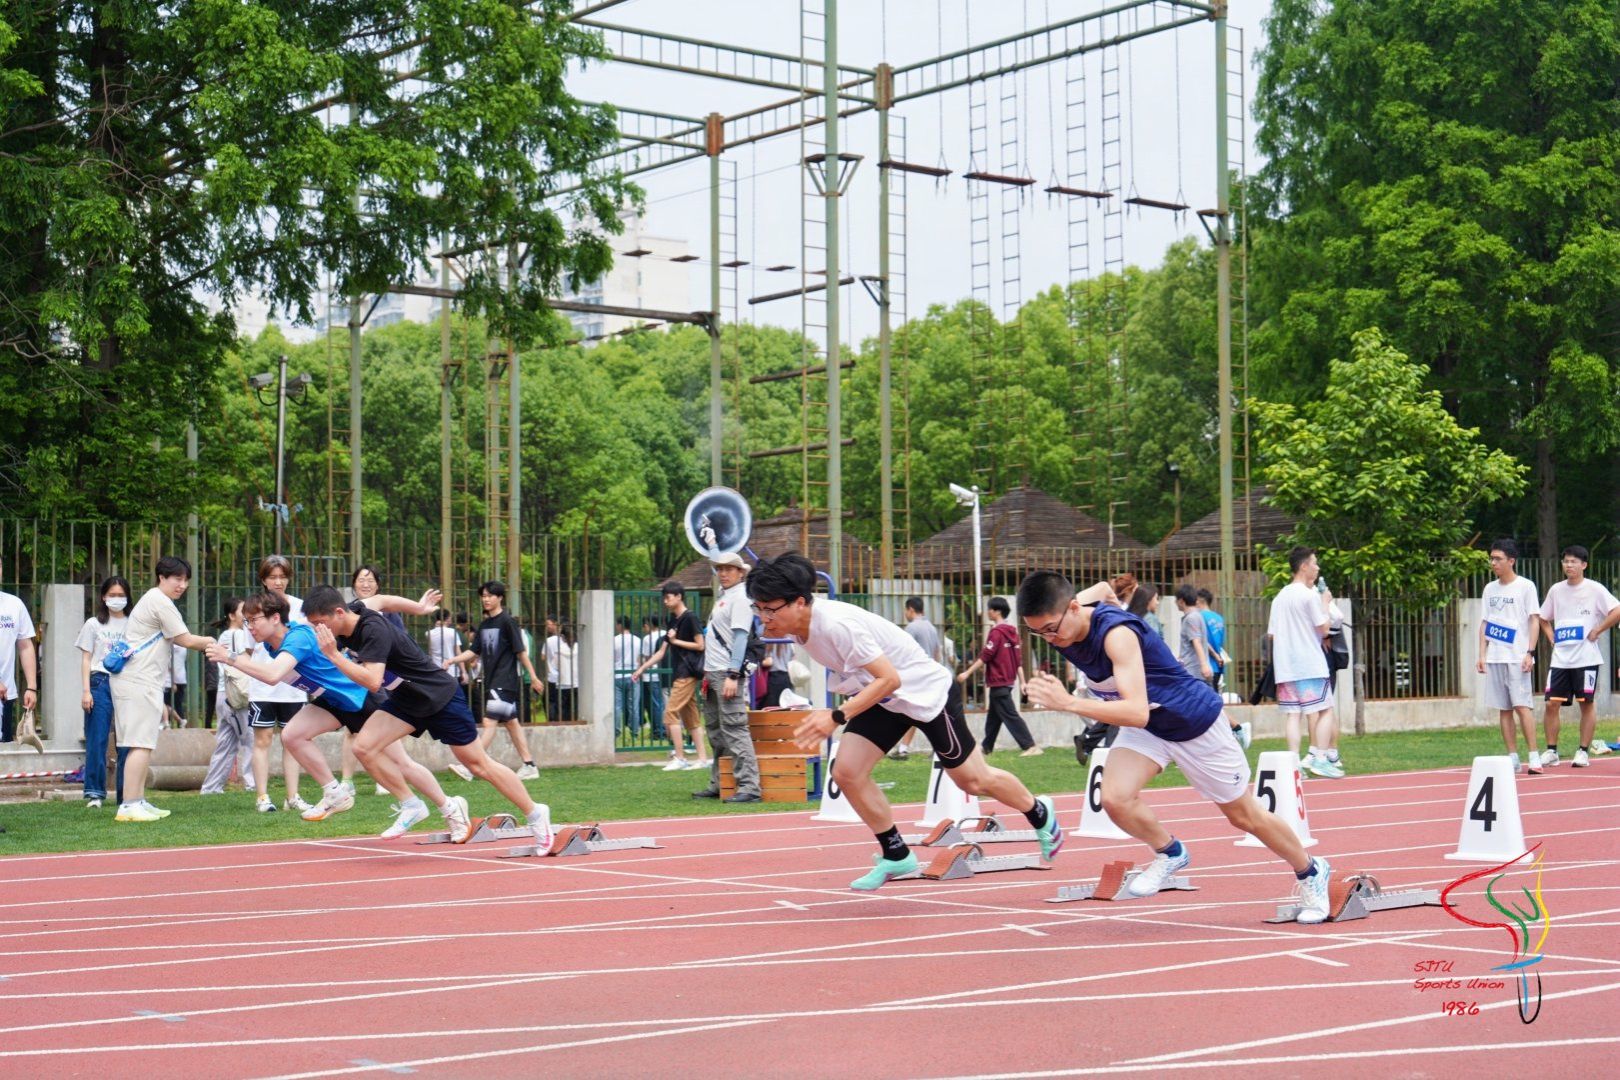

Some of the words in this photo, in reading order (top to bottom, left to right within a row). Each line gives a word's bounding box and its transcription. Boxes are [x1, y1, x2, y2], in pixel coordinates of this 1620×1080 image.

[1489, 625, 1509, 640] 0214
[1557, 628, 1577, 640] 0514
[1089, 765, 1104, 813] 6
[1257, 770, 1276, 814] 5
[1294, 769, 1305, 820] 5
[1470, 776, 1497, 832] 4
